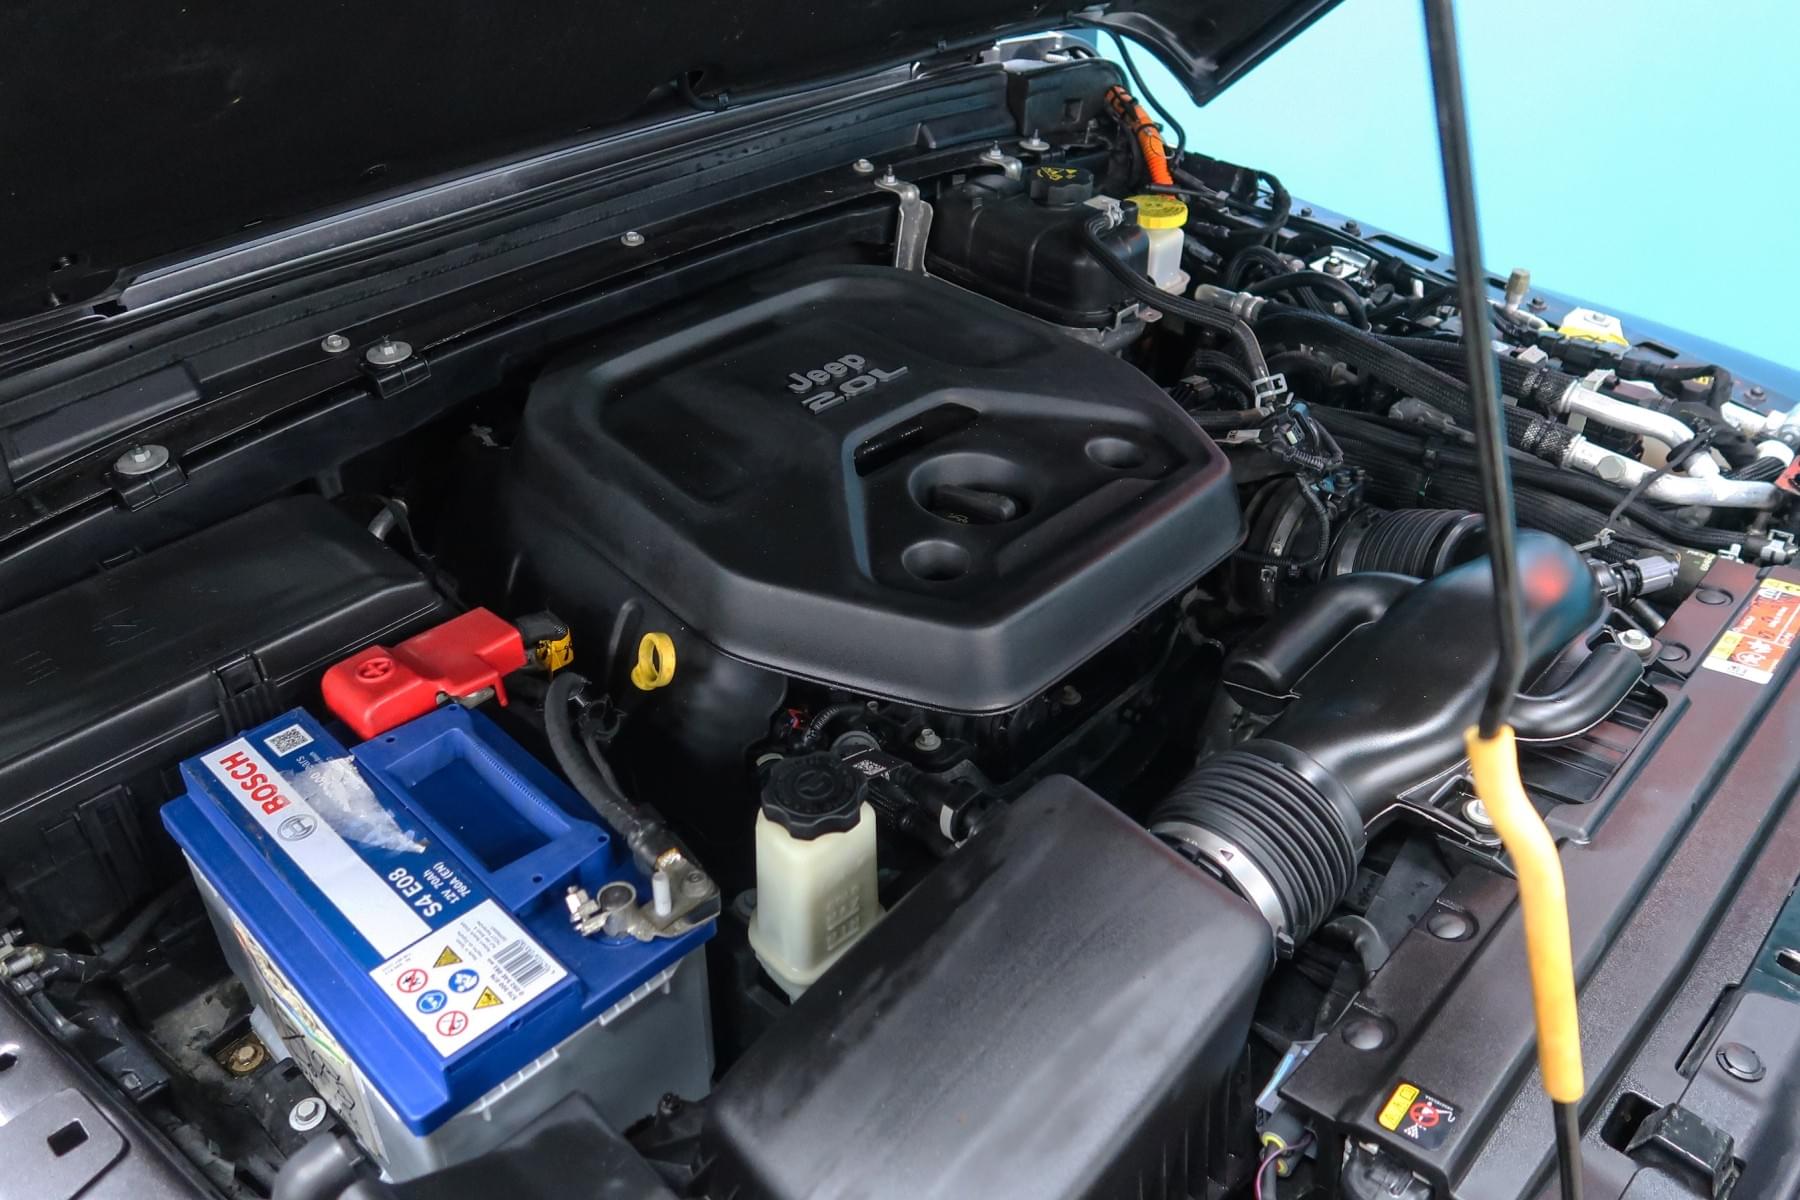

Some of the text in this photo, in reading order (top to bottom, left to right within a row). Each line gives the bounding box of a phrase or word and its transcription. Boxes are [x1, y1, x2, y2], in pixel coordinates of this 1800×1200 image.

[787, 353, 866, 393] Jeep
[219, 751, 292, 815] BOSCH
[388, 867, 443, 917] S4 E08
[423, 869, 460, 904] 12V 70Ah
[433, 861, 471, 898] 760A (EN)
